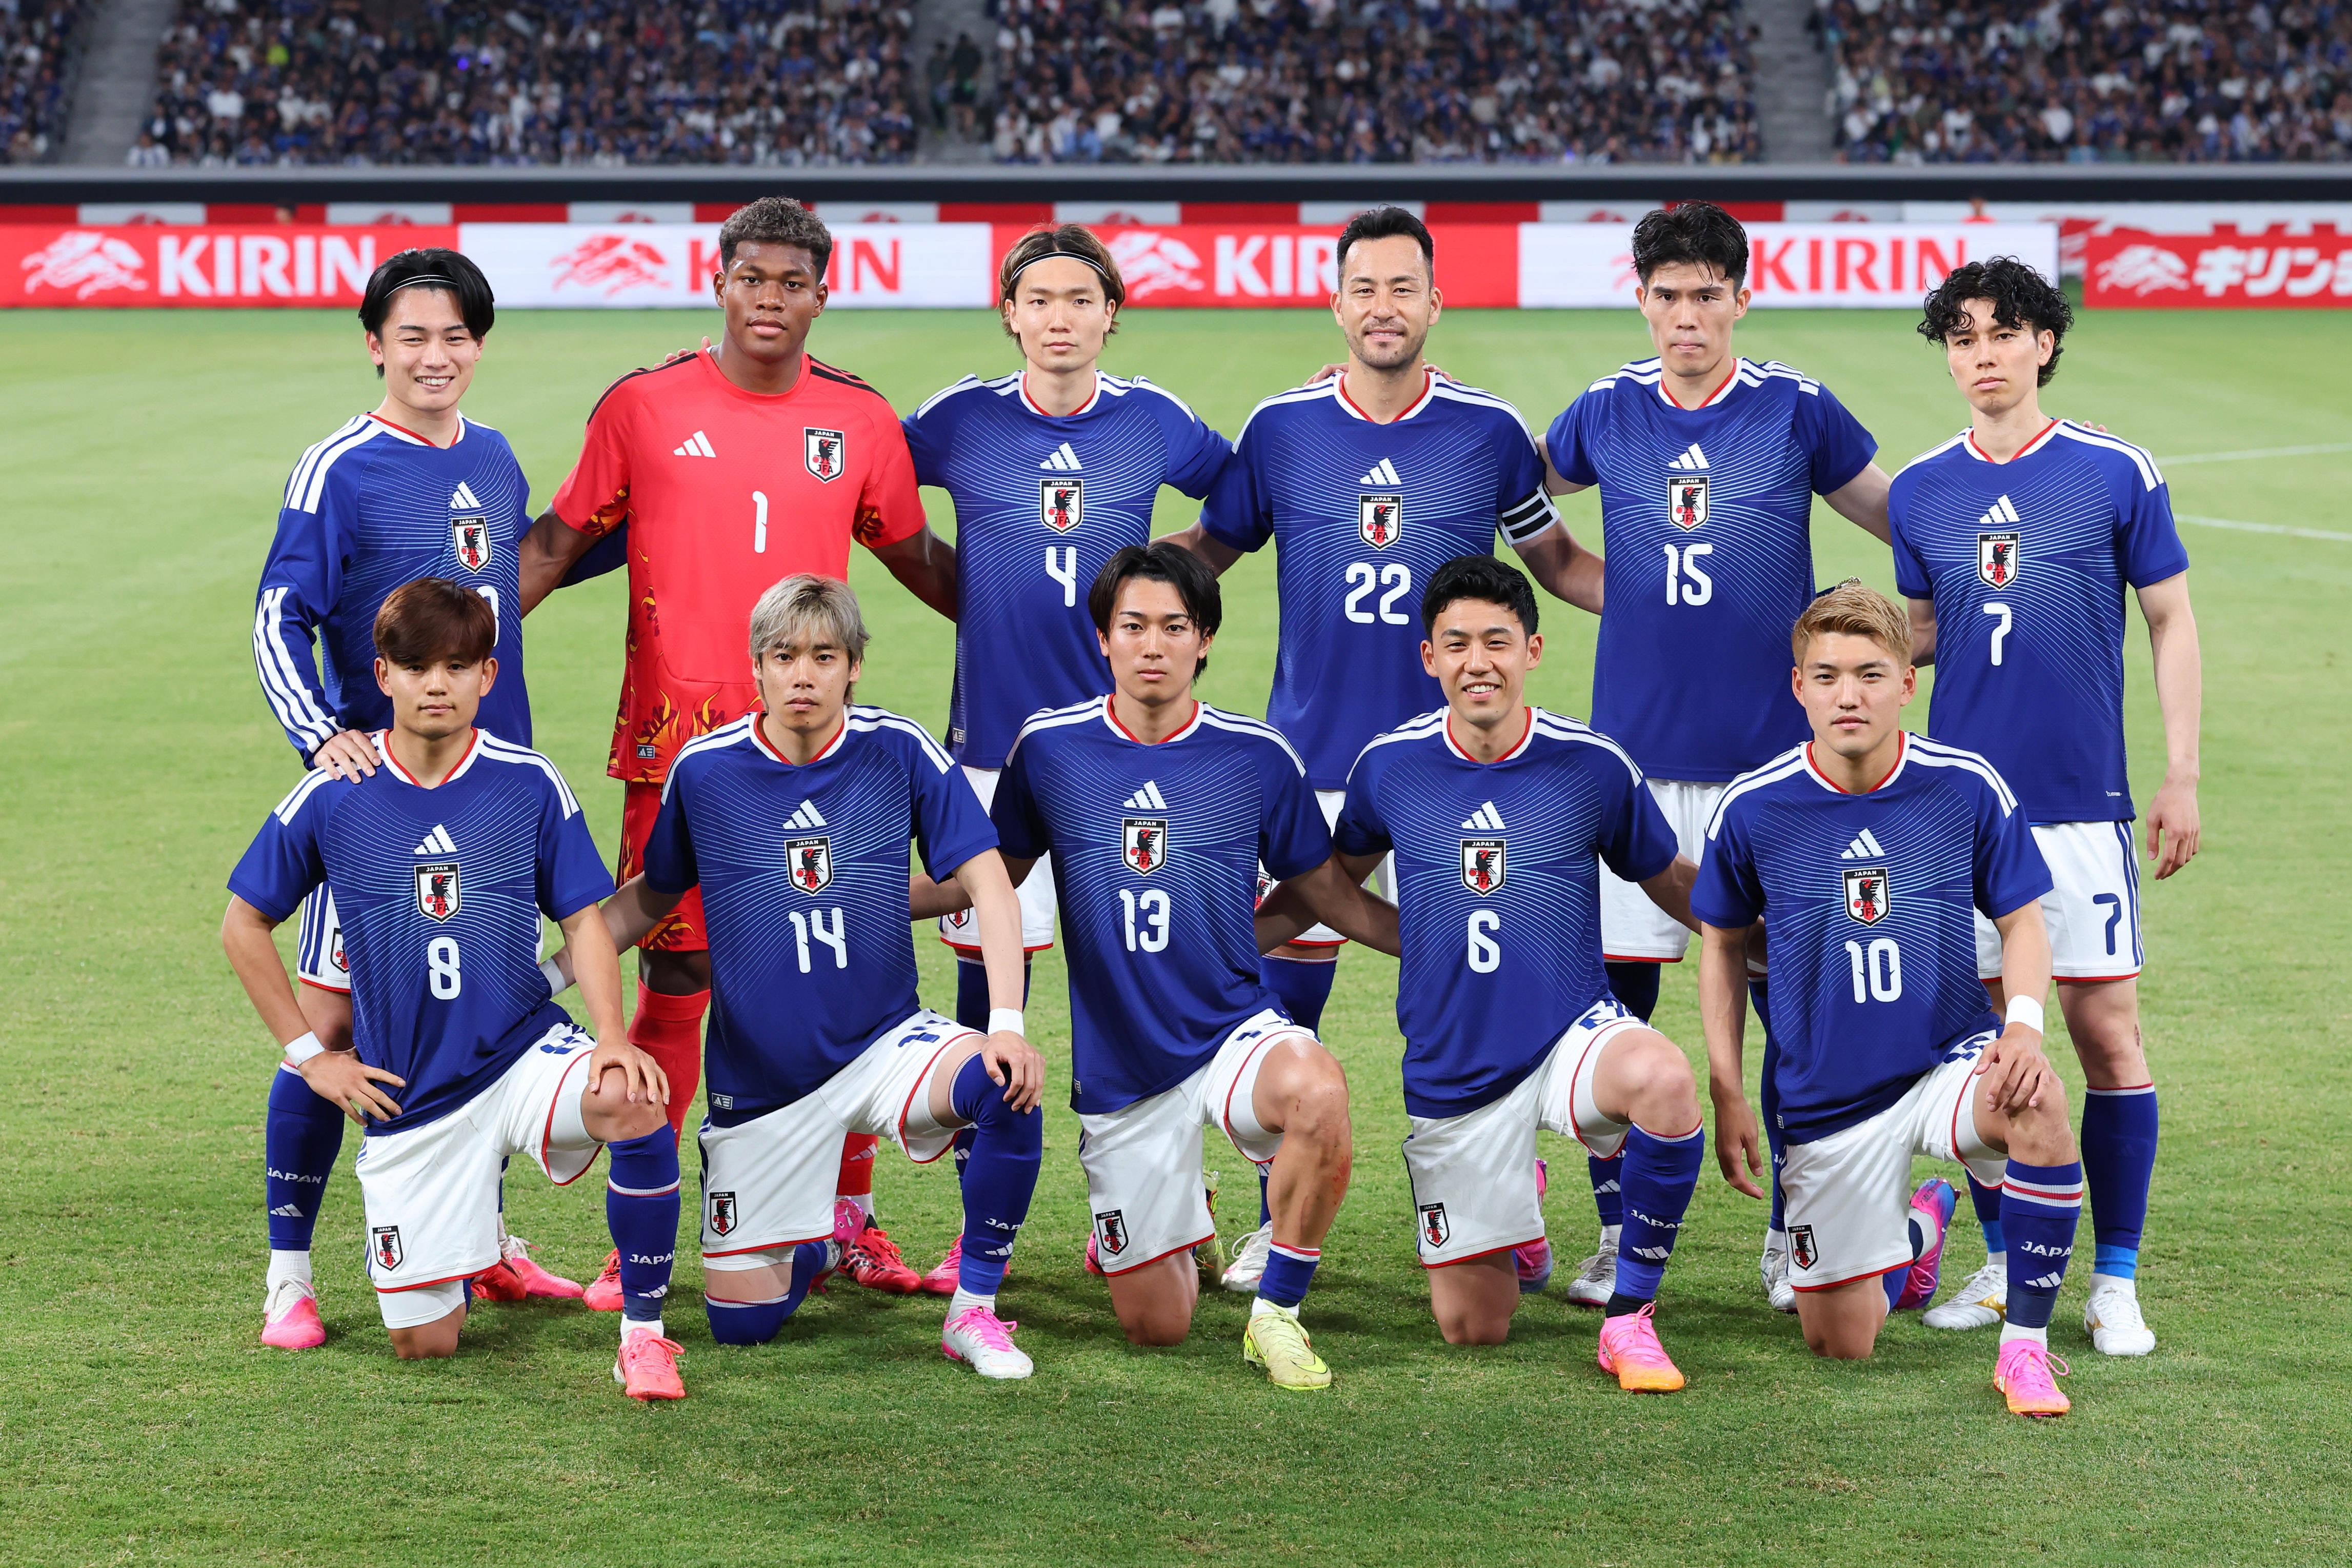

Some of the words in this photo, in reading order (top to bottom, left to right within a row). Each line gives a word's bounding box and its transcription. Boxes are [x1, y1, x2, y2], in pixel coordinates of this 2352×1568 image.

[158, 234, 376, 297] KIRIN
[689, 238, 900, 293] KIN
[1214, 235, 1339, 297] KIR
[1751, 238, 1967, 293] KIRIN
[817, 464, 833, 473] JFA
[752, 491, 768, 553] 1
[1680, 514, 1697, 522] JFA
[466, 554, 481, 564] JFA
[1046, 546, 1076, 607] 4
[1663, 544, 1713, 606] 15
[1990, 572, 2008, 580] JFA
[1344, 562, 1411, 625] 22
[1983, 602, 2012, 666] 7
[802, 876, 821, 886] JFA
[1135, 857, 1154, 865] JFA
[1474, 877, 1493, 886] JFA
[431, 903, 450, 913] JFA
[1119, 889, 1171, 953] 13
[1859, 908, 1879, 917] JFA
[2093, 892, 2121, 955] 7
[789, 907, 848, 973] 14
[1468, 910, 1500, 973] 6
[427, 937, 461, 1000] 8
[1845, 937, 1901, 1003] 10
[267, 1167, 322, 1184] JAPAN
[629, 1250, 675, 1265] JAPA
[2021, 1241, 2073, 1257] JAPA
